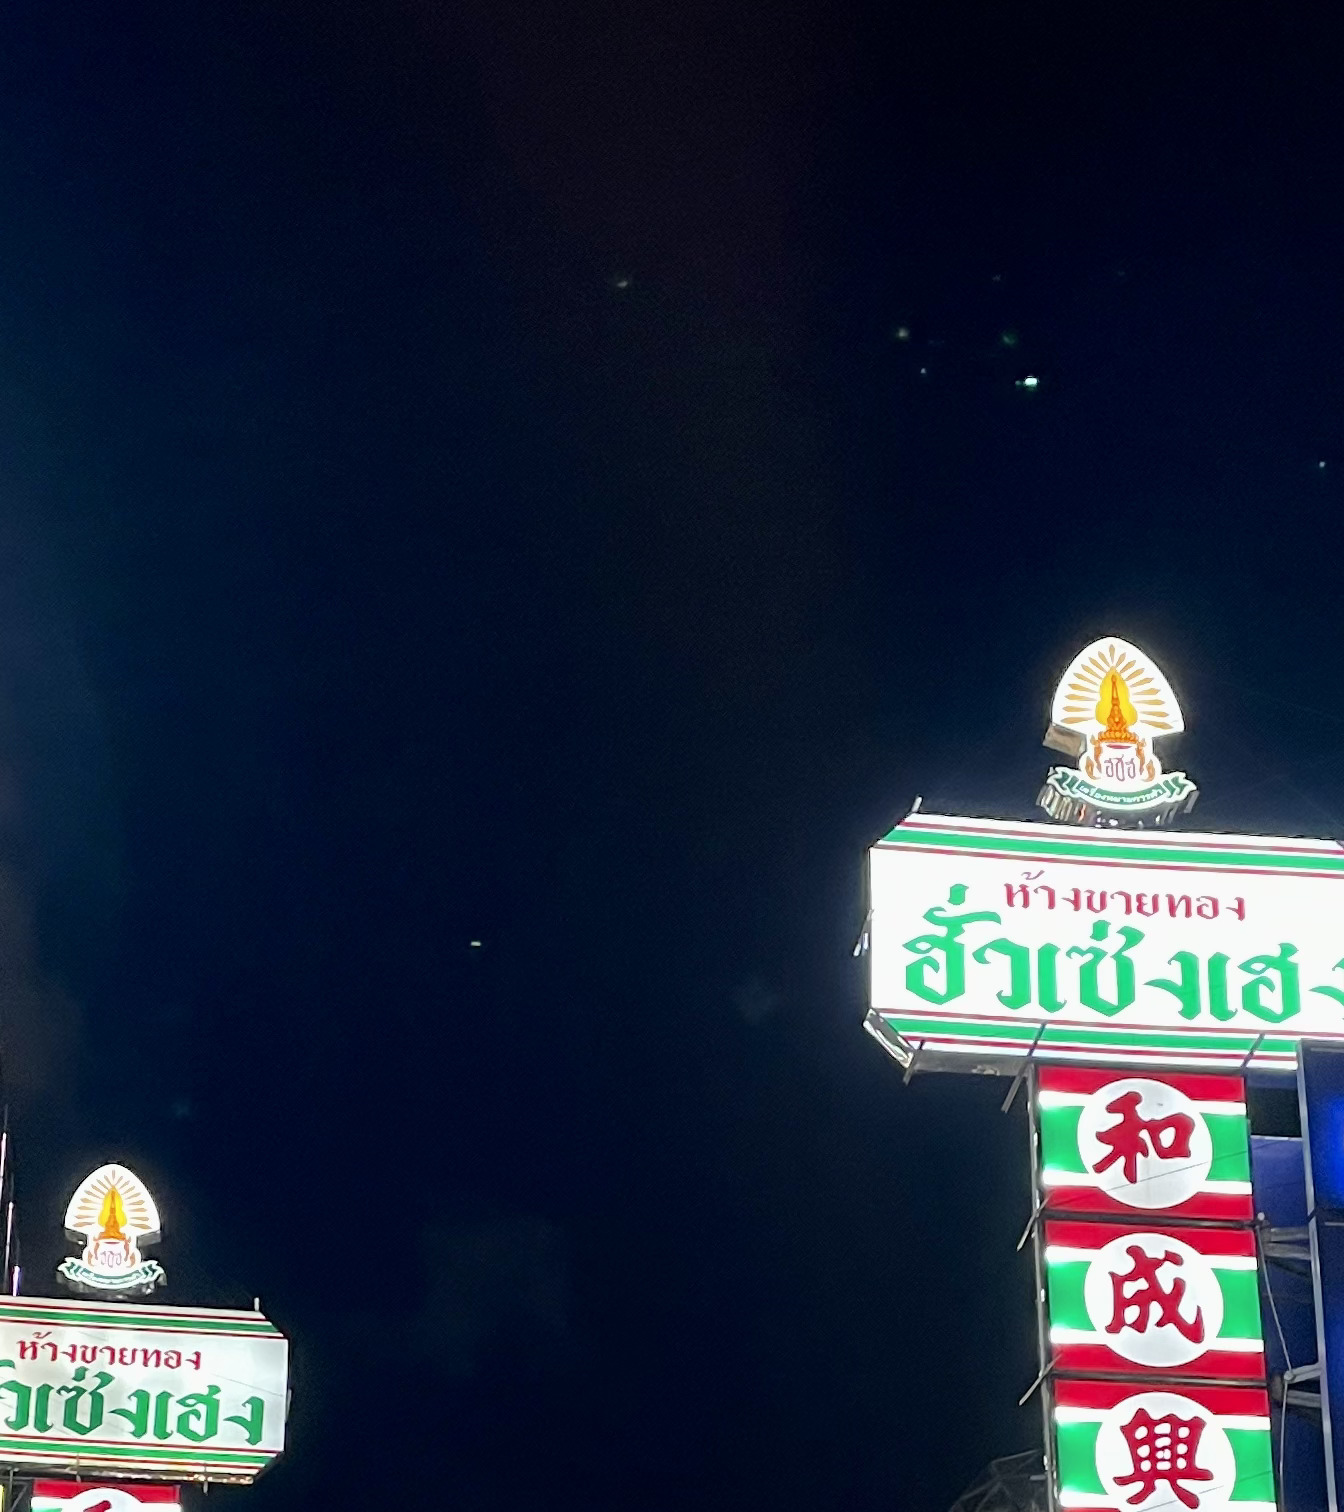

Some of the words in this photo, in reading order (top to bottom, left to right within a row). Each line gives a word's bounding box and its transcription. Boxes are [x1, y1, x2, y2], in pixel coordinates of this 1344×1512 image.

[1004, 869, 1247, 922] ห้างขายทอง
[17, 1331, 202, 1371] ห้างขายทอง
